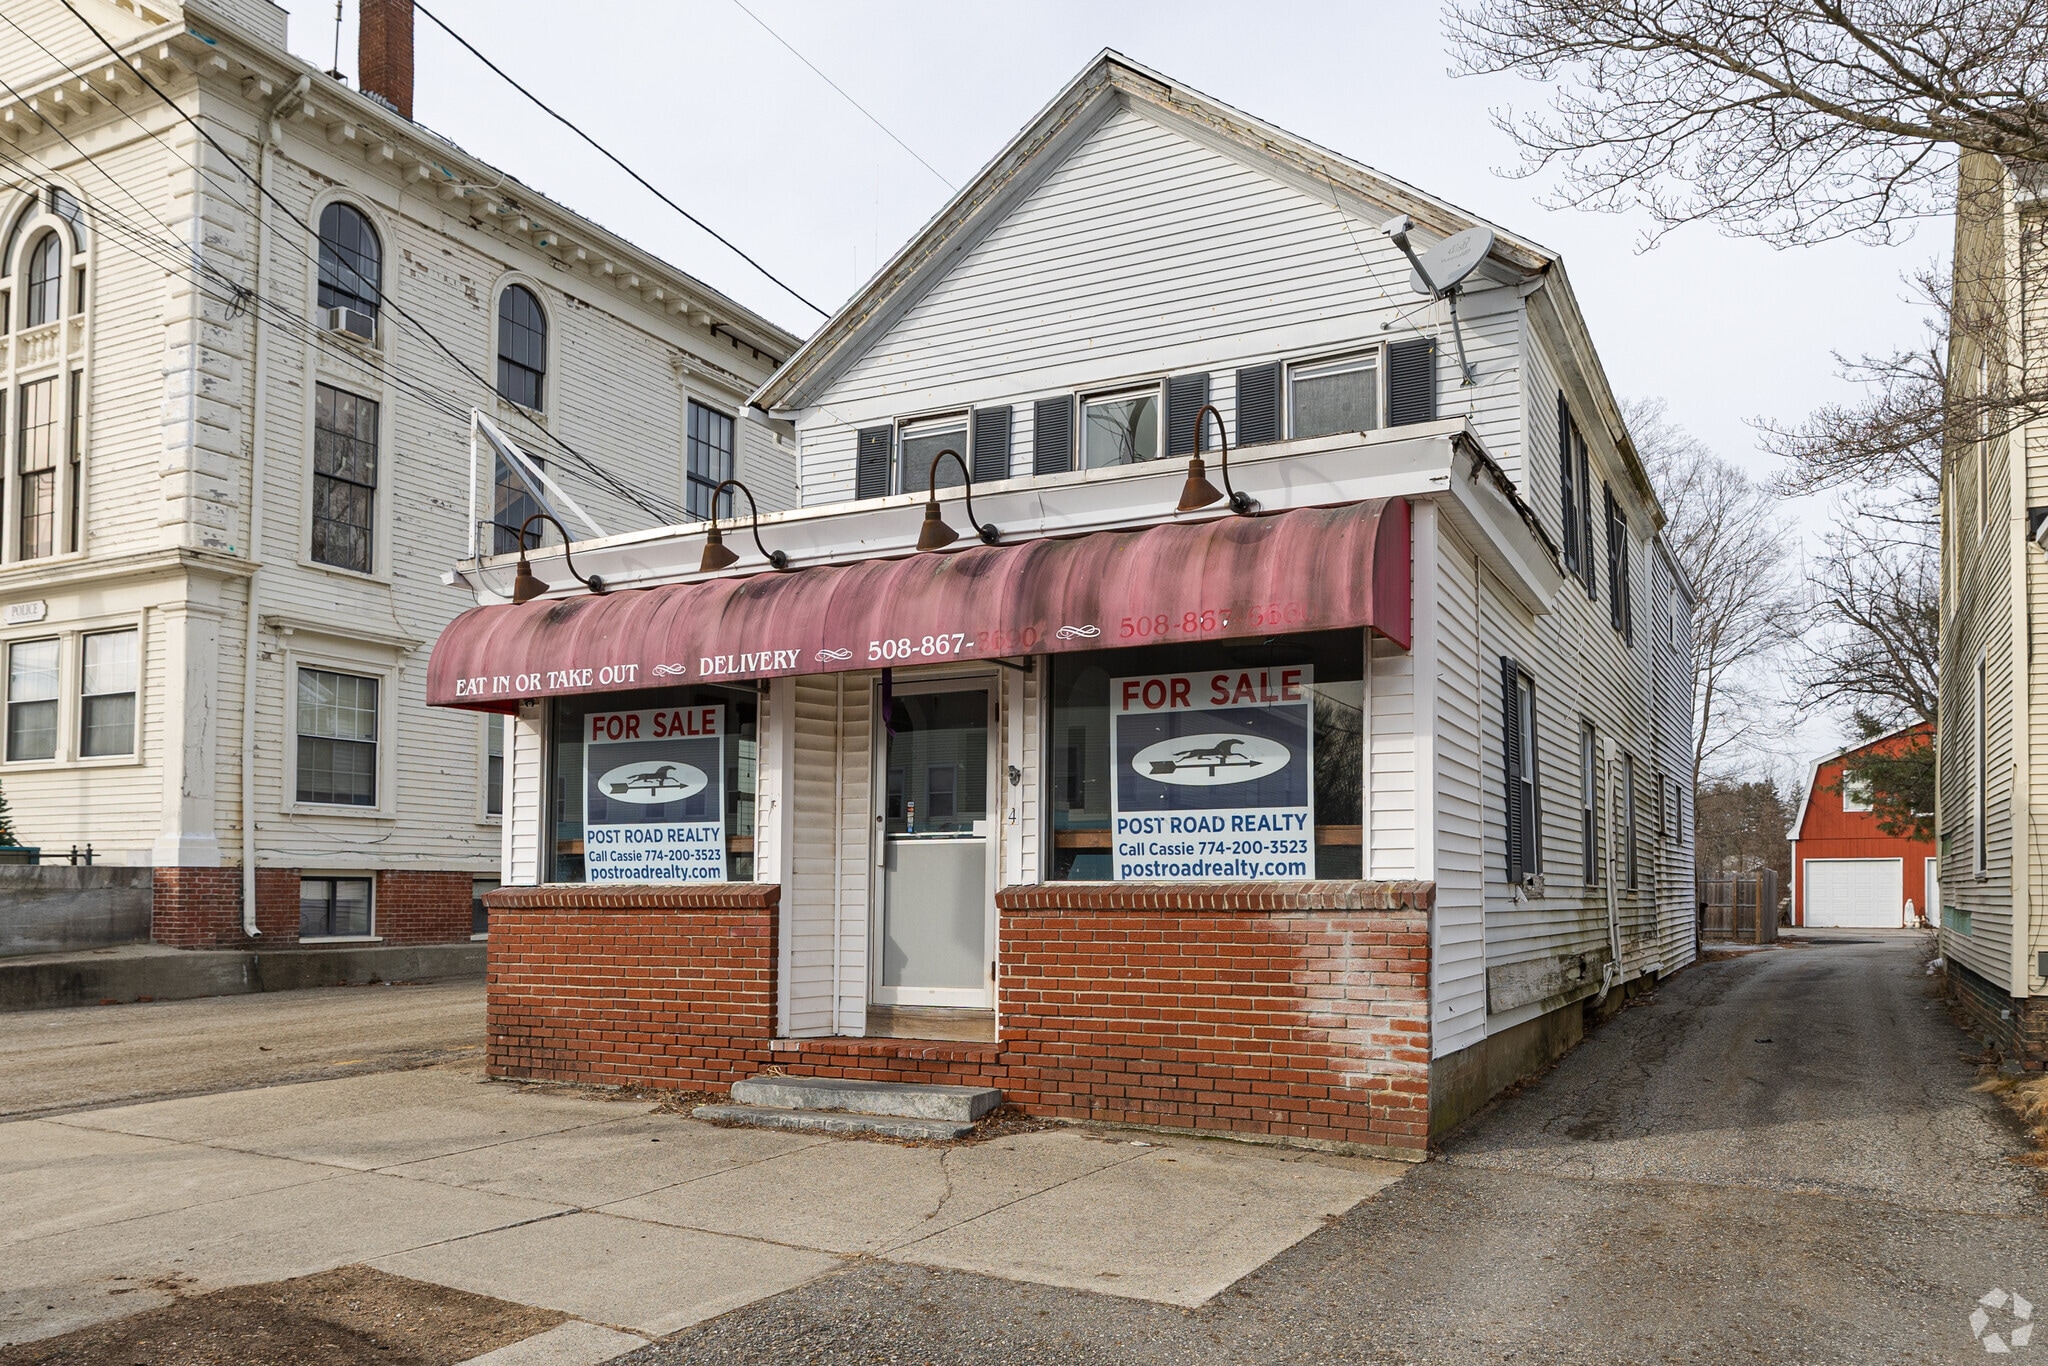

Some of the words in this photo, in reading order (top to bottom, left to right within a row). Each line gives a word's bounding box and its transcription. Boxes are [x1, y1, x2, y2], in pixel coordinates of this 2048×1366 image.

[11, 603, 38, 617] POLICE
[456, 677, 488, 697] EAT
[492, 675, 511, 694] IN
[515, 673, 542, 693] OR
[546, 668, 594, 690] TAKE
[599, 664, 639, 685] OUT
[699, 649, 801, 677] DELIVERY
[1122, 678, 1192, 711] FOR
[1209, 670, 1302, 705] SALE
[592, 714, 641, 742] FOR
[652, 709, 717, 738] SALE
[1008, 807, 1017, 825] 4
[1117, 817, 1165, 835] POST
[1170, 815, 1226, 834] ROAD
[1231, 813, 1308, 832] REALTY
[587, 829, 621, 845] POST
[625, 828, 664, 844] ROAD
[667, 827, 721, 843] REALTY
[588, 850, 608, 863] Call
[610, 849, 643, 862] Cassie
[645, 848, 721, 862] 774-200-3523
[1118, 842, 1145, 856] Call
[1149, 842, 1194, 856] Cassie
[1198, 839, 1308, 855] 774-200-3523
[591, 864, 721, 882] postroadrealty.com
[1121, 859, 1307, 880] postroadrealty.com
